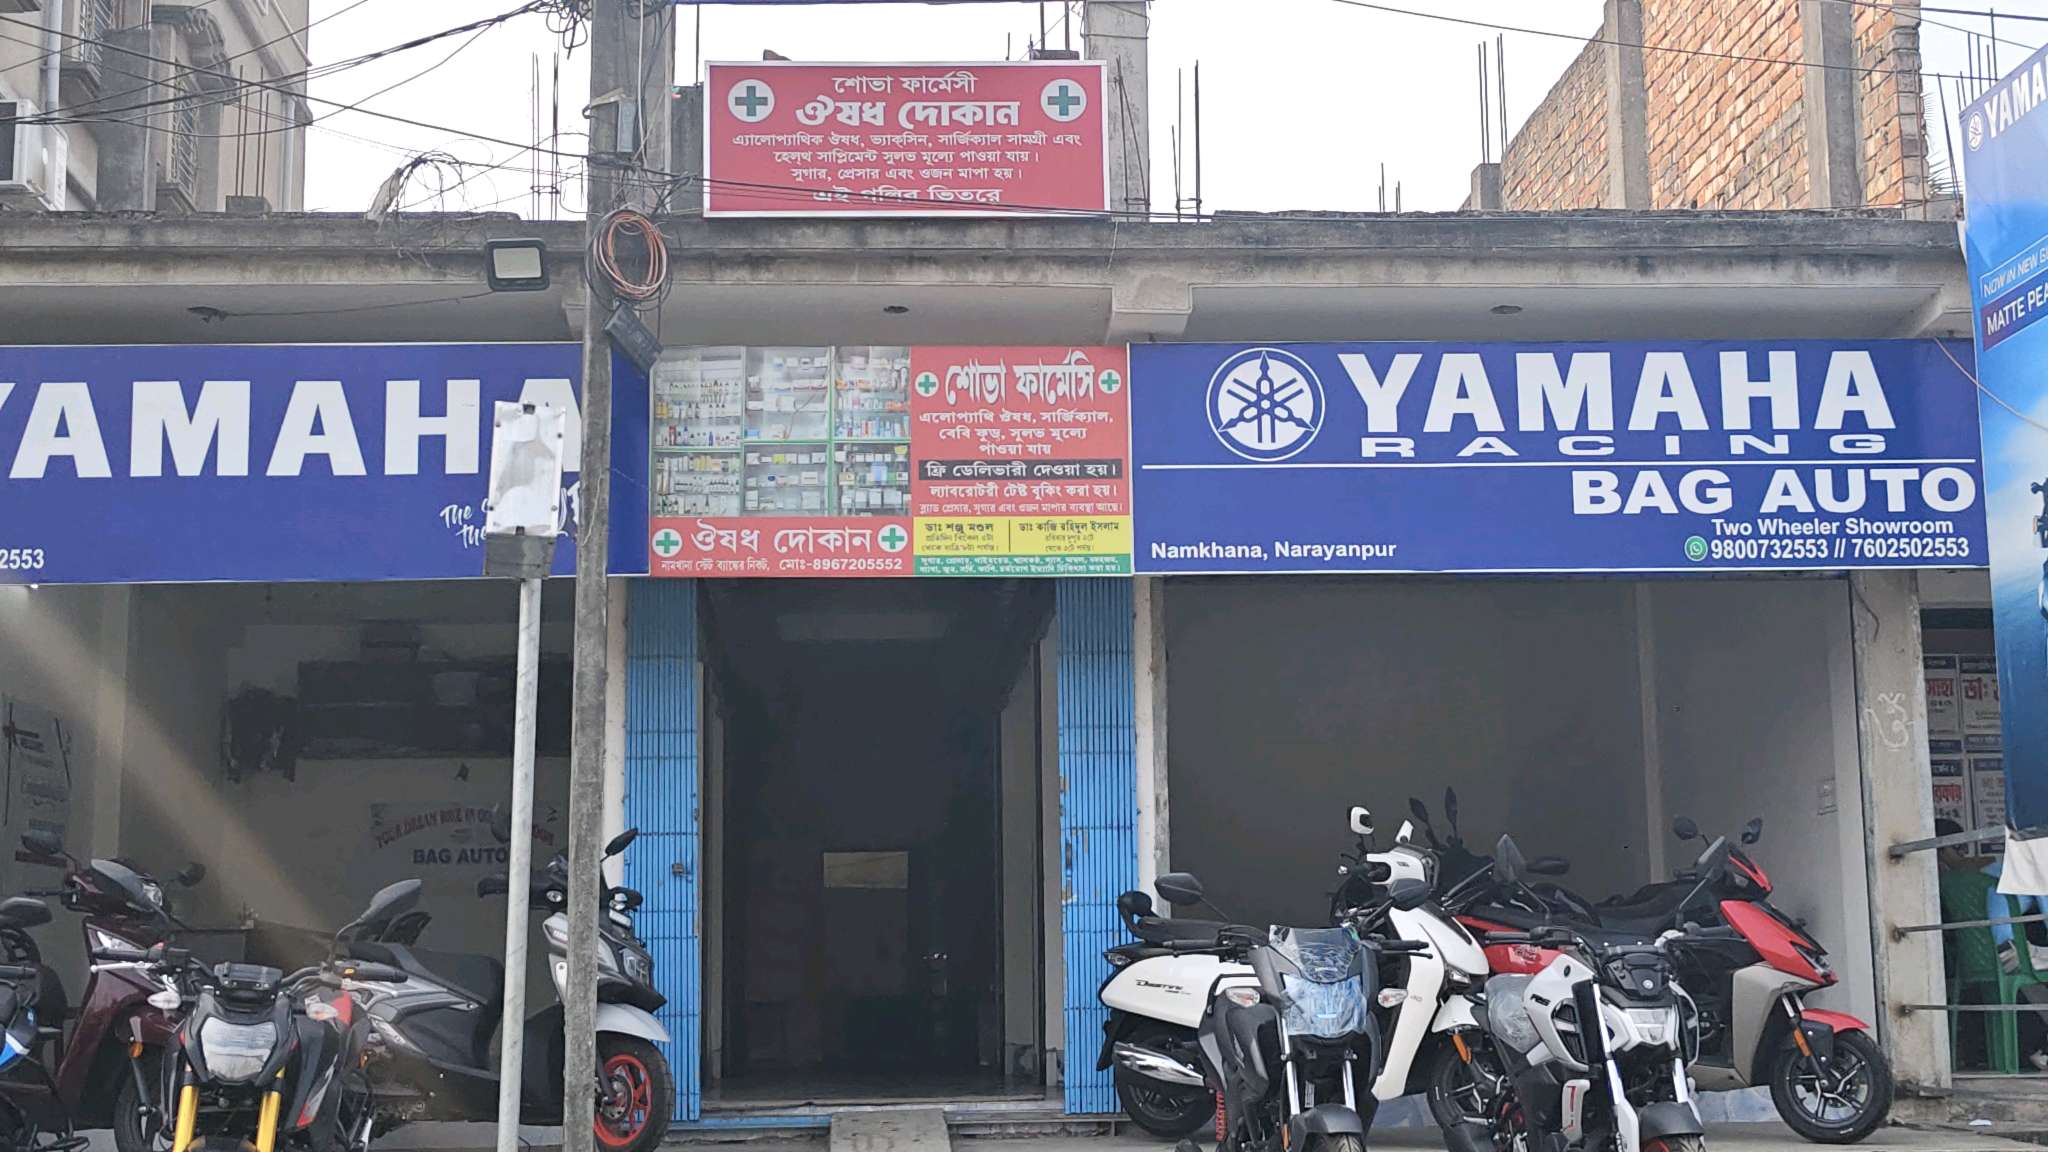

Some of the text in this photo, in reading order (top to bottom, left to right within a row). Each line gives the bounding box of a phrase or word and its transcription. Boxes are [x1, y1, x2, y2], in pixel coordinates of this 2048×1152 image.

[832, 72, 976, 96] শোভা ফার্মেসী
[1984, 54, 2048, 138] YAMA
[795, 96, 1020, 129] ঔষধ দোকান
[1052, 134, 1082, 146] এবং
[960, 151, 999, 163] পাওয়া
[838, 168, 880, 181] প্রেসার
[885, 168, 915, 181] এবং
[920, 167, 953, 180] ওজন
[957, 168, 989, 180] মাপা
[927, 185, 1002, 203] ভিতরে
[1986, 296, 2026, 336] MATTE
[945, 347, 1095, 405] শোভা ফার্মেসি
[1337, 350, 1896, 433] YAMAHA
[939, 425, 971, 440] বেবি
[1361, 433, 1887, 458] RACING
[925, 461, 946, 478] ফ্রি
[952, 461, 1027, 478] ডেলিভারী
[1033, 463, 1080, 478] দেওয়া
[1572, 467, 1976, 515] BAG AUTO
[691, 519, 872, 554] ঔষধ দোকান
[1711, 516, 1953, 536] Two Wheeler Showroom
[1151, 541, 1396, 562] Namkhana, Narayanpur
[1711, 538, 1828, 559] 9800732553
[1851, 538, 1969, 558] 7602502553
[413, 848, 509, 865] BAG AUTO
